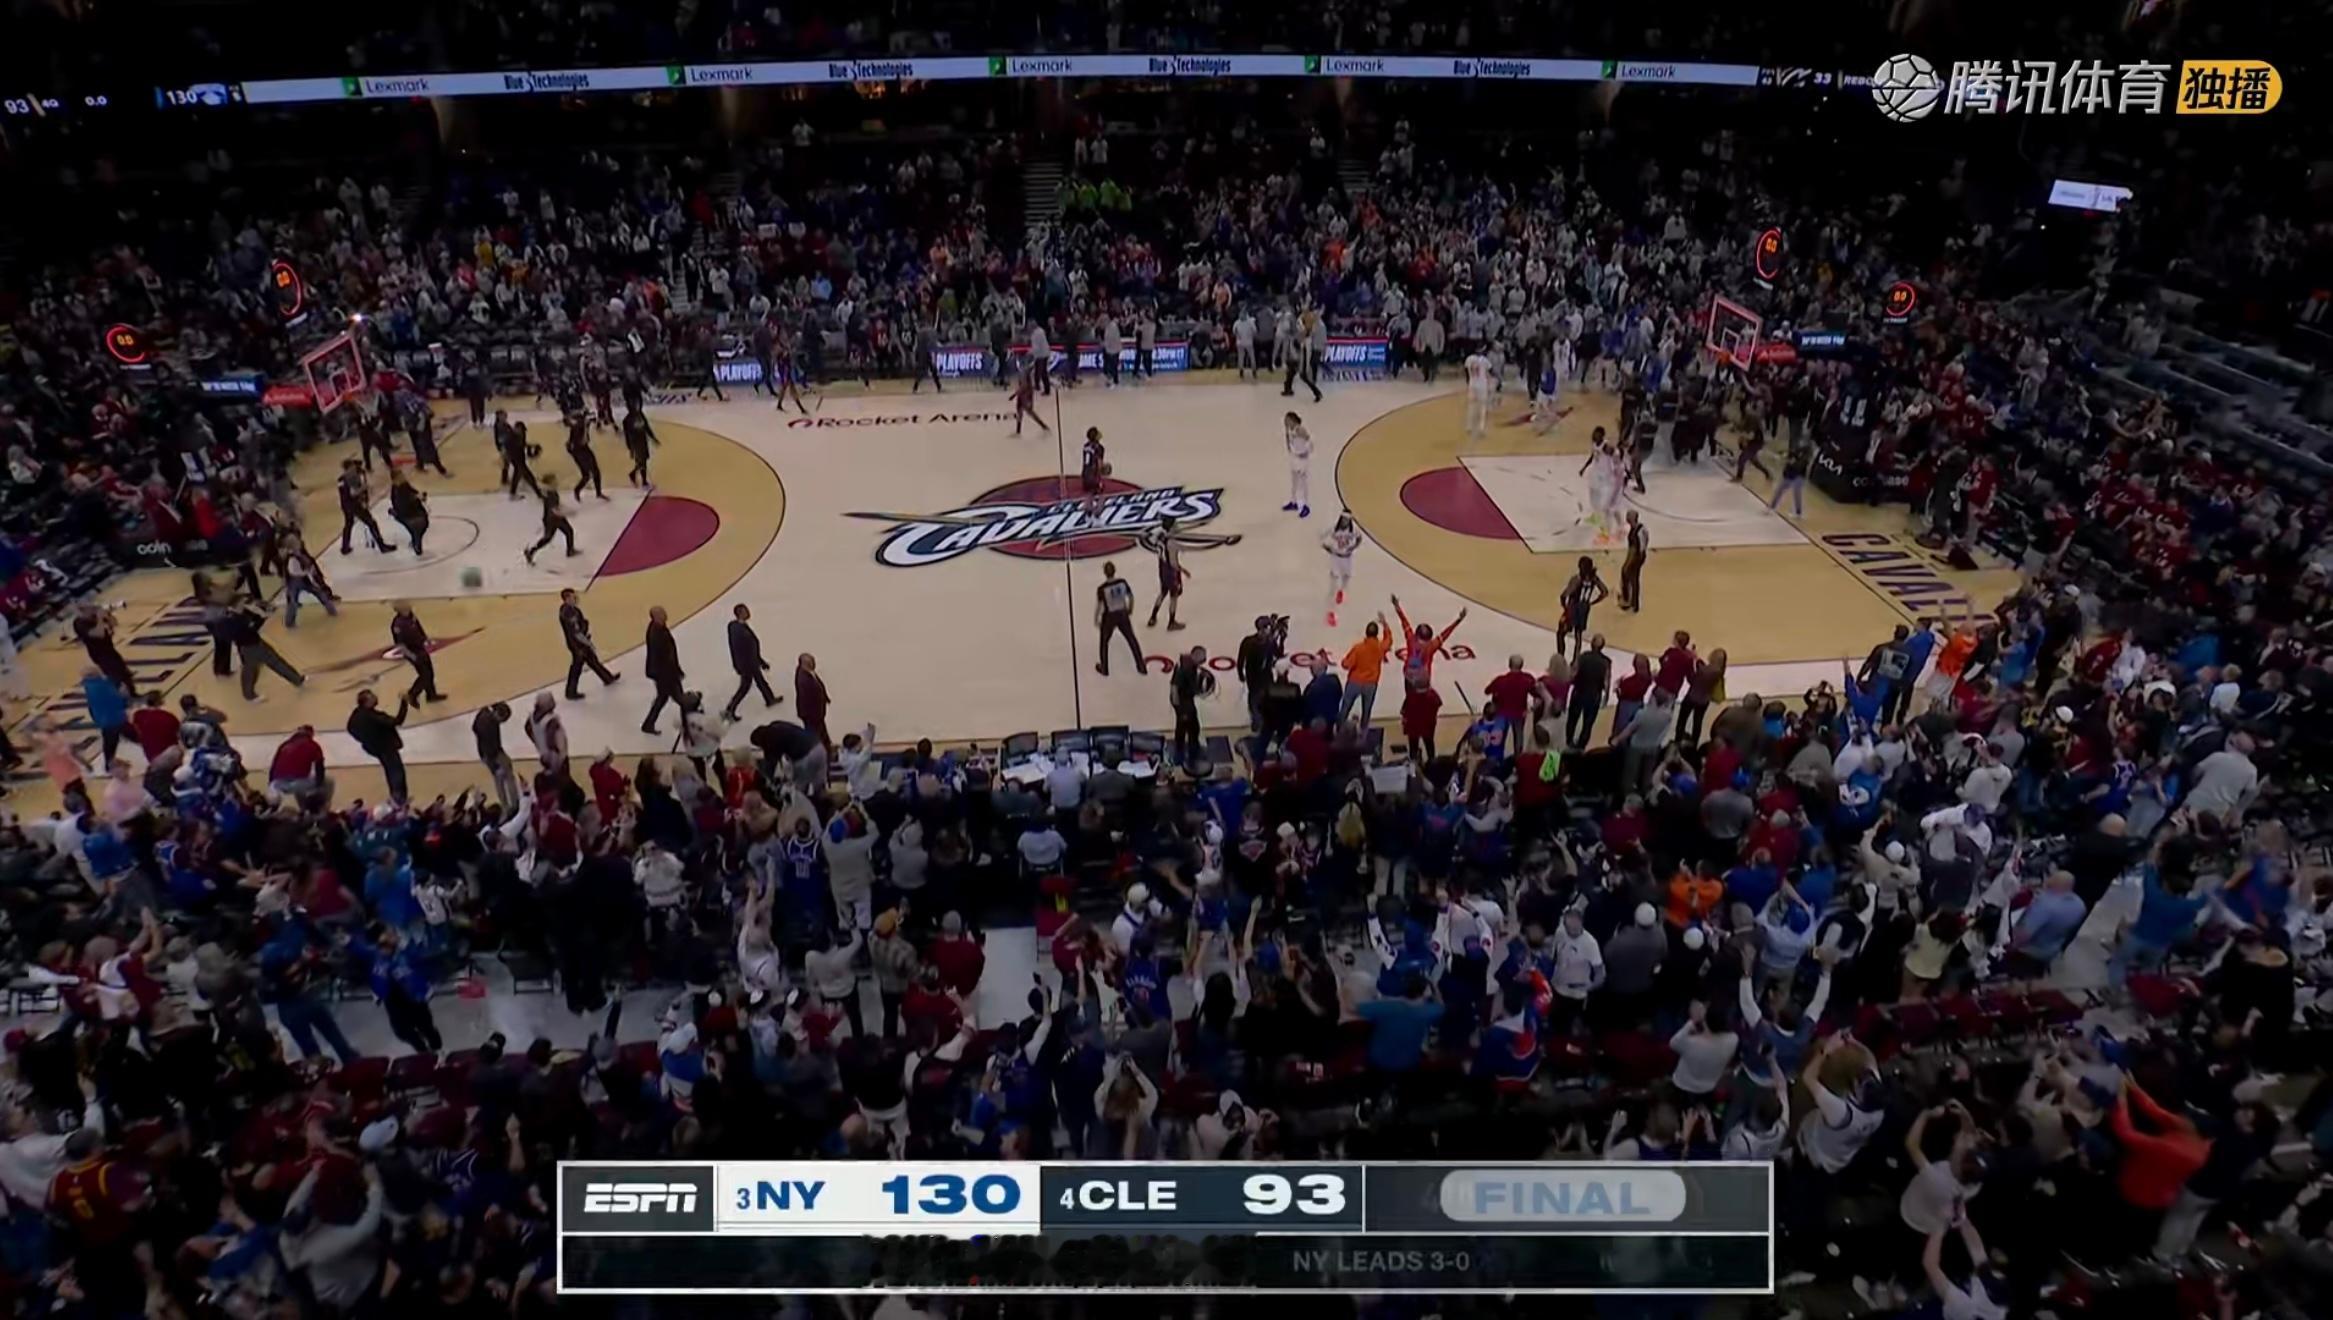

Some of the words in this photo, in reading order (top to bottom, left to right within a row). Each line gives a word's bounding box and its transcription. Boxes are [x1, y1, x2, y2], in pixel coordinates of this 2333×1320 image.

[829, 63, 848, 78] Blue
[857, 61, 913, 80] Technologies
[1012, 58, 1073, 72] Lexmark
[1149, 58, 1167, 72] Blue
[1177, 58, 1231, 76] Technologies
[1326, 58, 1384, 72] Lexmark
[1454, 61, 1471, 74] Blue
[1480, 60, 1531, 78] Technologies
[1621, 64, 1675, 79] Lexmark
[691, 67, 753, 82] Lexmark
[1813, 72, 1832, 84] 33
[366, 78, 429, 93] Lexmark
[504, 75, 524, 90] Blue
[532, 73, 590, 92] Technologies
[84, 95, 107, 106] 0.0
[166, 90, 198, 105] 130
[1324, 344, 1367, 363] PLAYOFFS
[936, 352, 983, 371] PLAYOFFS
[817, 414, 920, 428] Rocket
[928, 411, 1018, 424] Arena
